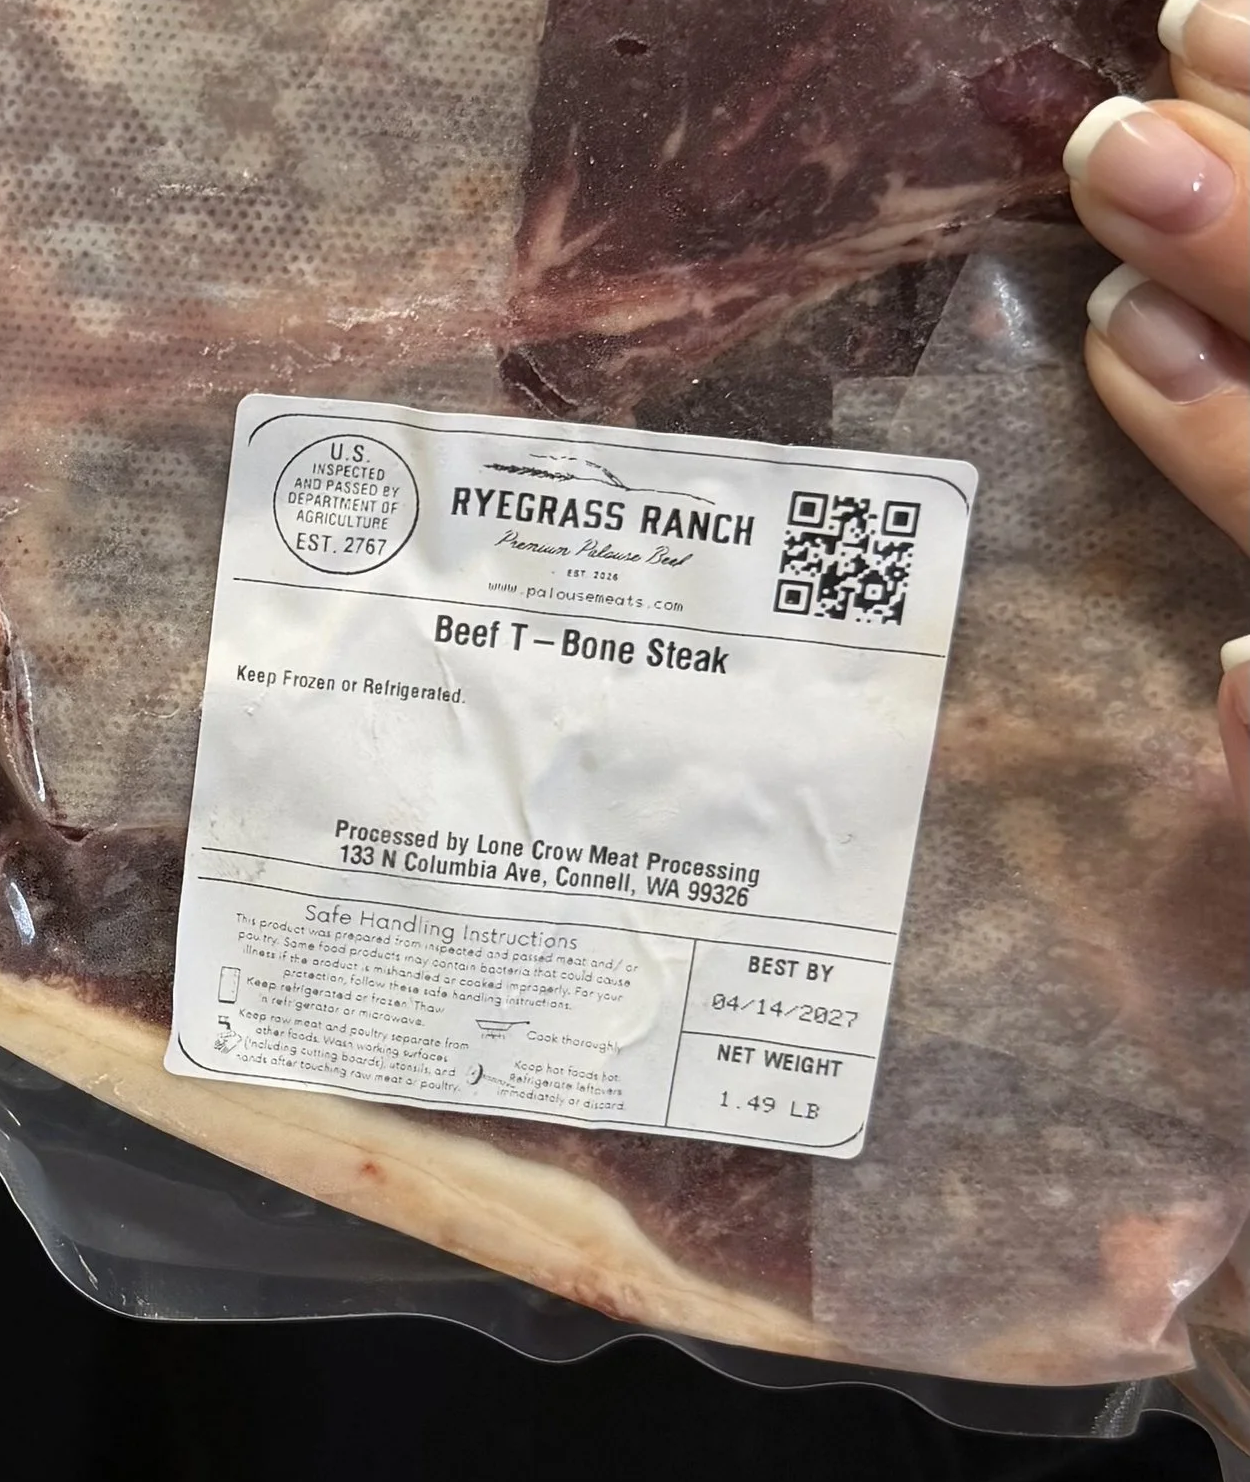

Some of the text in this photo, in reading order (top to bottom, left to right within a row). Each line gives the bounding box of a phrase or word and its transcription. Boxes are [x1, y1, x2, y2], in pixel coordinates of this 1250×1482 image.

[330, 442, 371, 463] U.S.
[312, 463, 385, 481] INSPECTED
[287, 491, 398, 514] DEPARTMENT OF
[294, 477, 400, 498] AND PASSED BY
[296, 509, 389, 531] AGRICULTURE
[451, 487, 755, 546] RYEGRASS RANCH
[296, 532, 387, 556] EST. 2767
[494, 529, 694, 568] Premium Palouse Beef
[593, 570, 618, 582] 2026
[488, 582, 684, 612] www.palousemeats.com
[434, 614, 501, 649] Beef
[561, 628, 635, 665] Bone
[646, 637, 729, 675] Steak
[236, 664, 465, 704] Keep Frozen or Refrigerated.
[335, 819, 760, 888] Processed by Lone Crow Meat Processing
[340, 844, 750, 908] 133 N Columbia Ave, Connell, WA 99326
[305, 904, 578, 950] Safe Handling Instructions
[259, 920, 305, 935] product
[309, 929, 331, 938] was
[334, 931, 391, 945] prepared
[512, 953, 554, 963] passed
[556, 956, 587, 967] meat
[283, 936, 315, 951] Some
[748, 955, 835, 983] BEST BY
[452, 989, 502, 1008] handling
[711, 993, 859, 1028] 04/14/2027
[717, 1043, 844, 1077] NET WEIGHT
[720, 1090, 820, 1120] 1.49 LB
